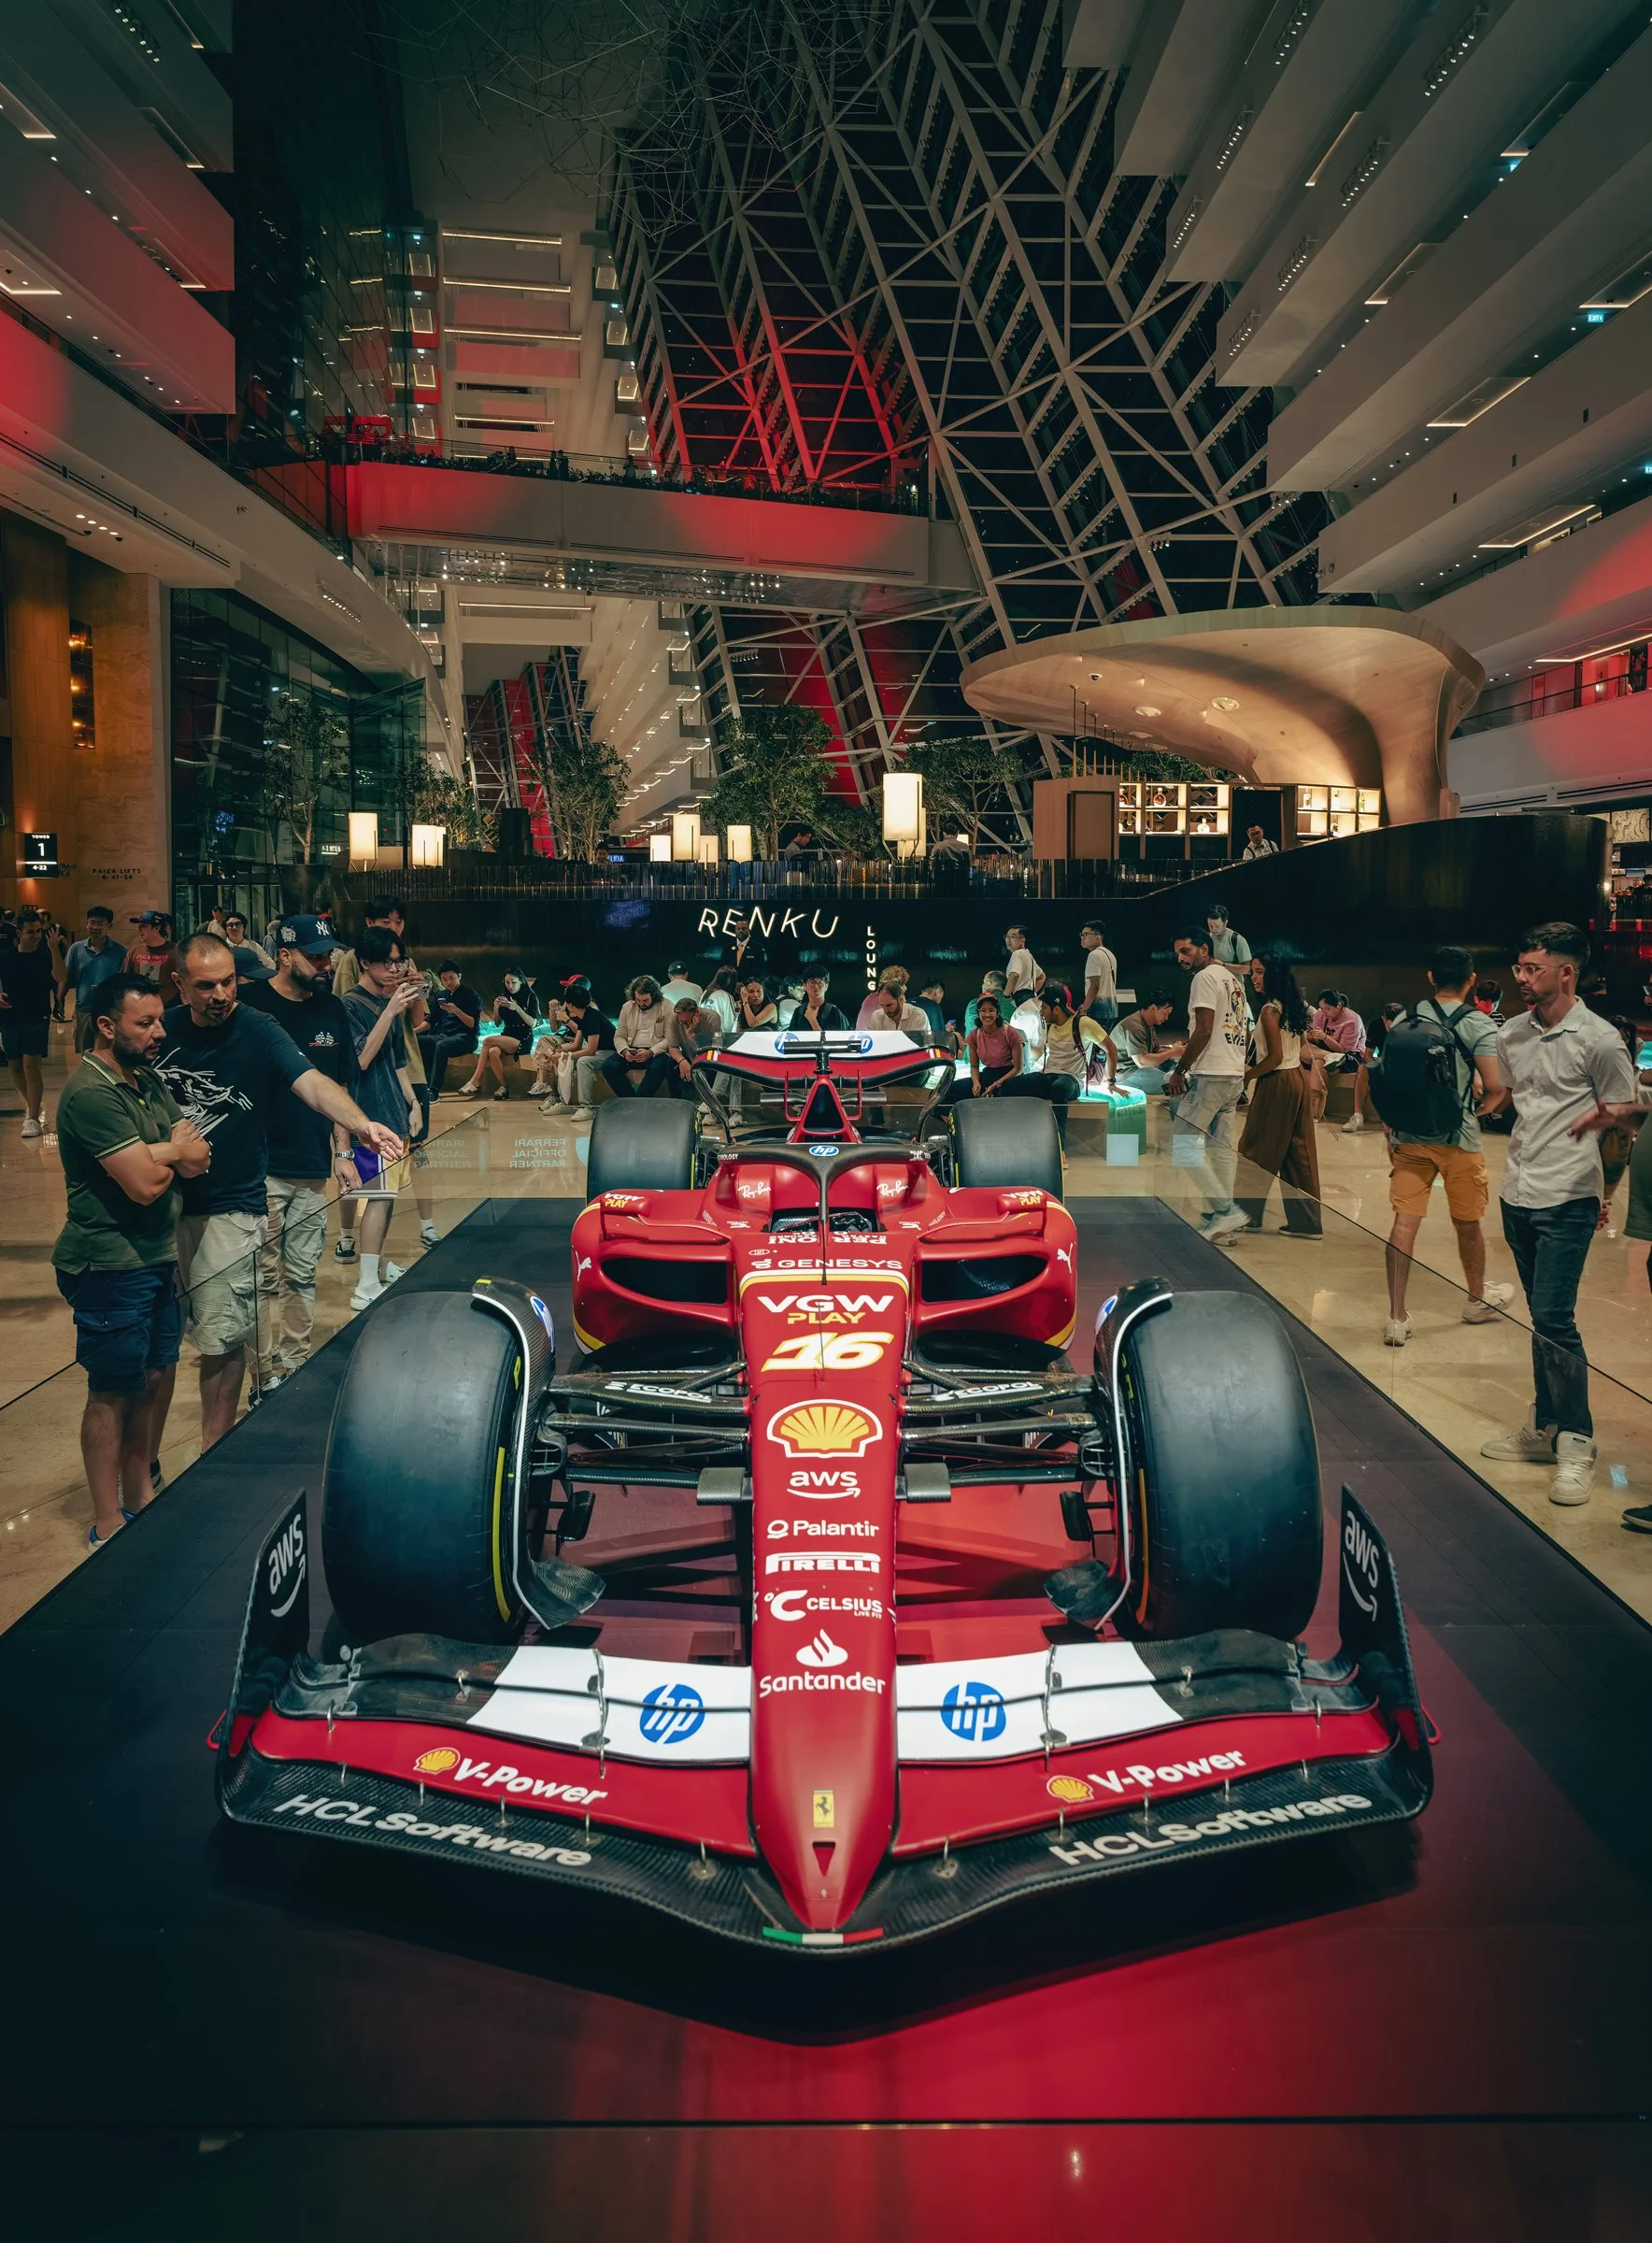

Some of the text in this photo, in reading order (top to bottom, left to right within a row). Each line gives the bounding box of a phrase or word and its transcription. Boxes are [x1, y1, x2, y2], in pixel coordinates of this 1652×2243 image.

[37, 842, 45, 857] 1
[697, 905, 840, 938] RENKU
[865, 925, 877, 992] LOUNG
[815, 1146, 836, 1157] hp
[737, 1181, 772, 1198] Ray-Ban
[876, 1180, 909, 1196] Ray-Ban
[1019, 1195, 1041, 1206] PLAY
[605, 1198, 628, 1208] PLAY
[777, 1258, 904, 1270] GENESYS
[757, 1294, 894, 1313] VGW
[787, 1311, 866, 1324] PLAY
[761, 1331, 895, 1373] 16
[790, 1470, 858, 1487] aws
[792, 1519, 880, 1537] Palantir
[268, 1513, 304, 1595] aws
[1345, 1510, 1380, 1589] aws
[765, 1551, 881, 1576] PIRELLI
[806, 1597, 883, 1613] CELSIUS
[759, 1671, 887, 1698] Santander
[642, 1683, 699, 1744] hp
[951, 1682, 1001, 1741] hp
[453, 1758, 607, 1806] V-Power
[1088, 1748, 1245, 1793] V-Power
[274, 1793, 593, 1866] HCLSoftware
[1047, 1792, 1374, 1865] HCLSoftware
